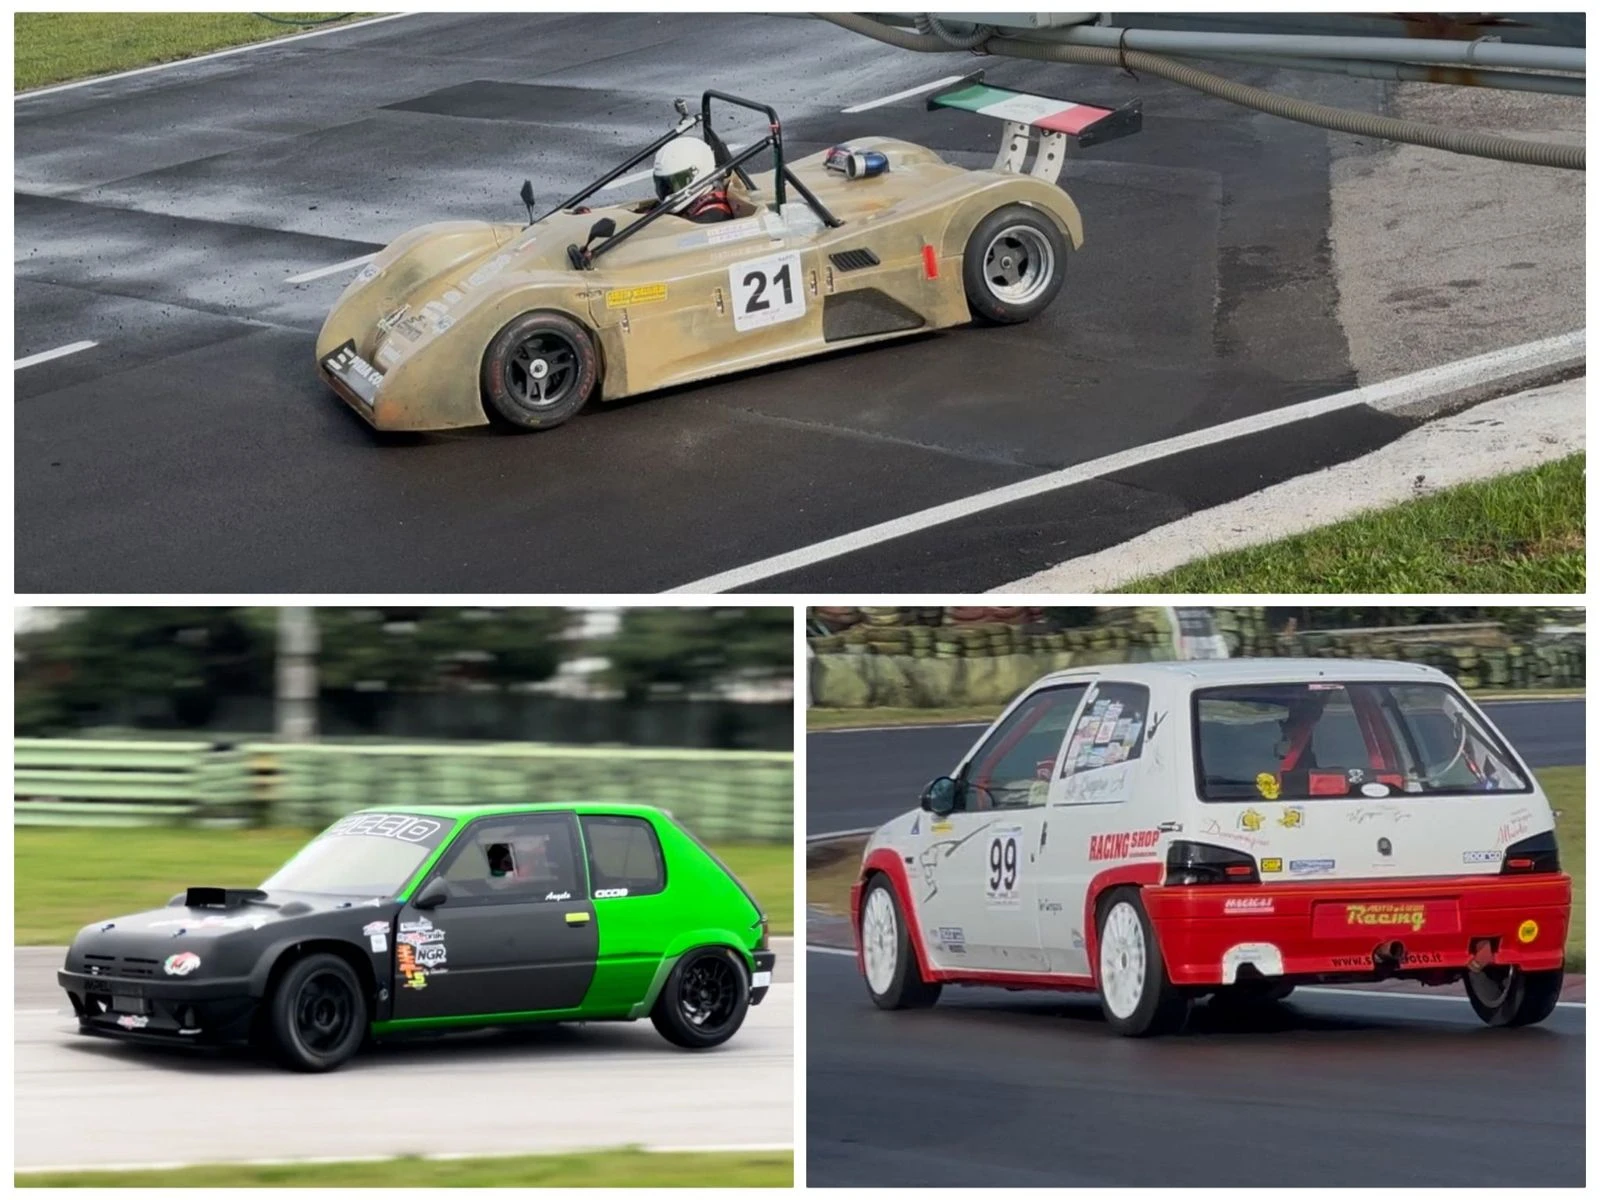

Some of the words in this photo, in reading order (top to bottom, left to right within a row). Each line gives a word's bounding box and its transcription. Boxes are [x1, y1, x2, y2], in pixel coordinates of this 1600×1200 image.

[743, 264, 794, 314] 21
[1089, 833, 1130, 861] RACING
[1130, 830, 1160, 848] SHOP
[988, 837, 1017, 891] 99
[1346, 904, 1426, 932] Racing
[418, 949, 444, 961] NGR
